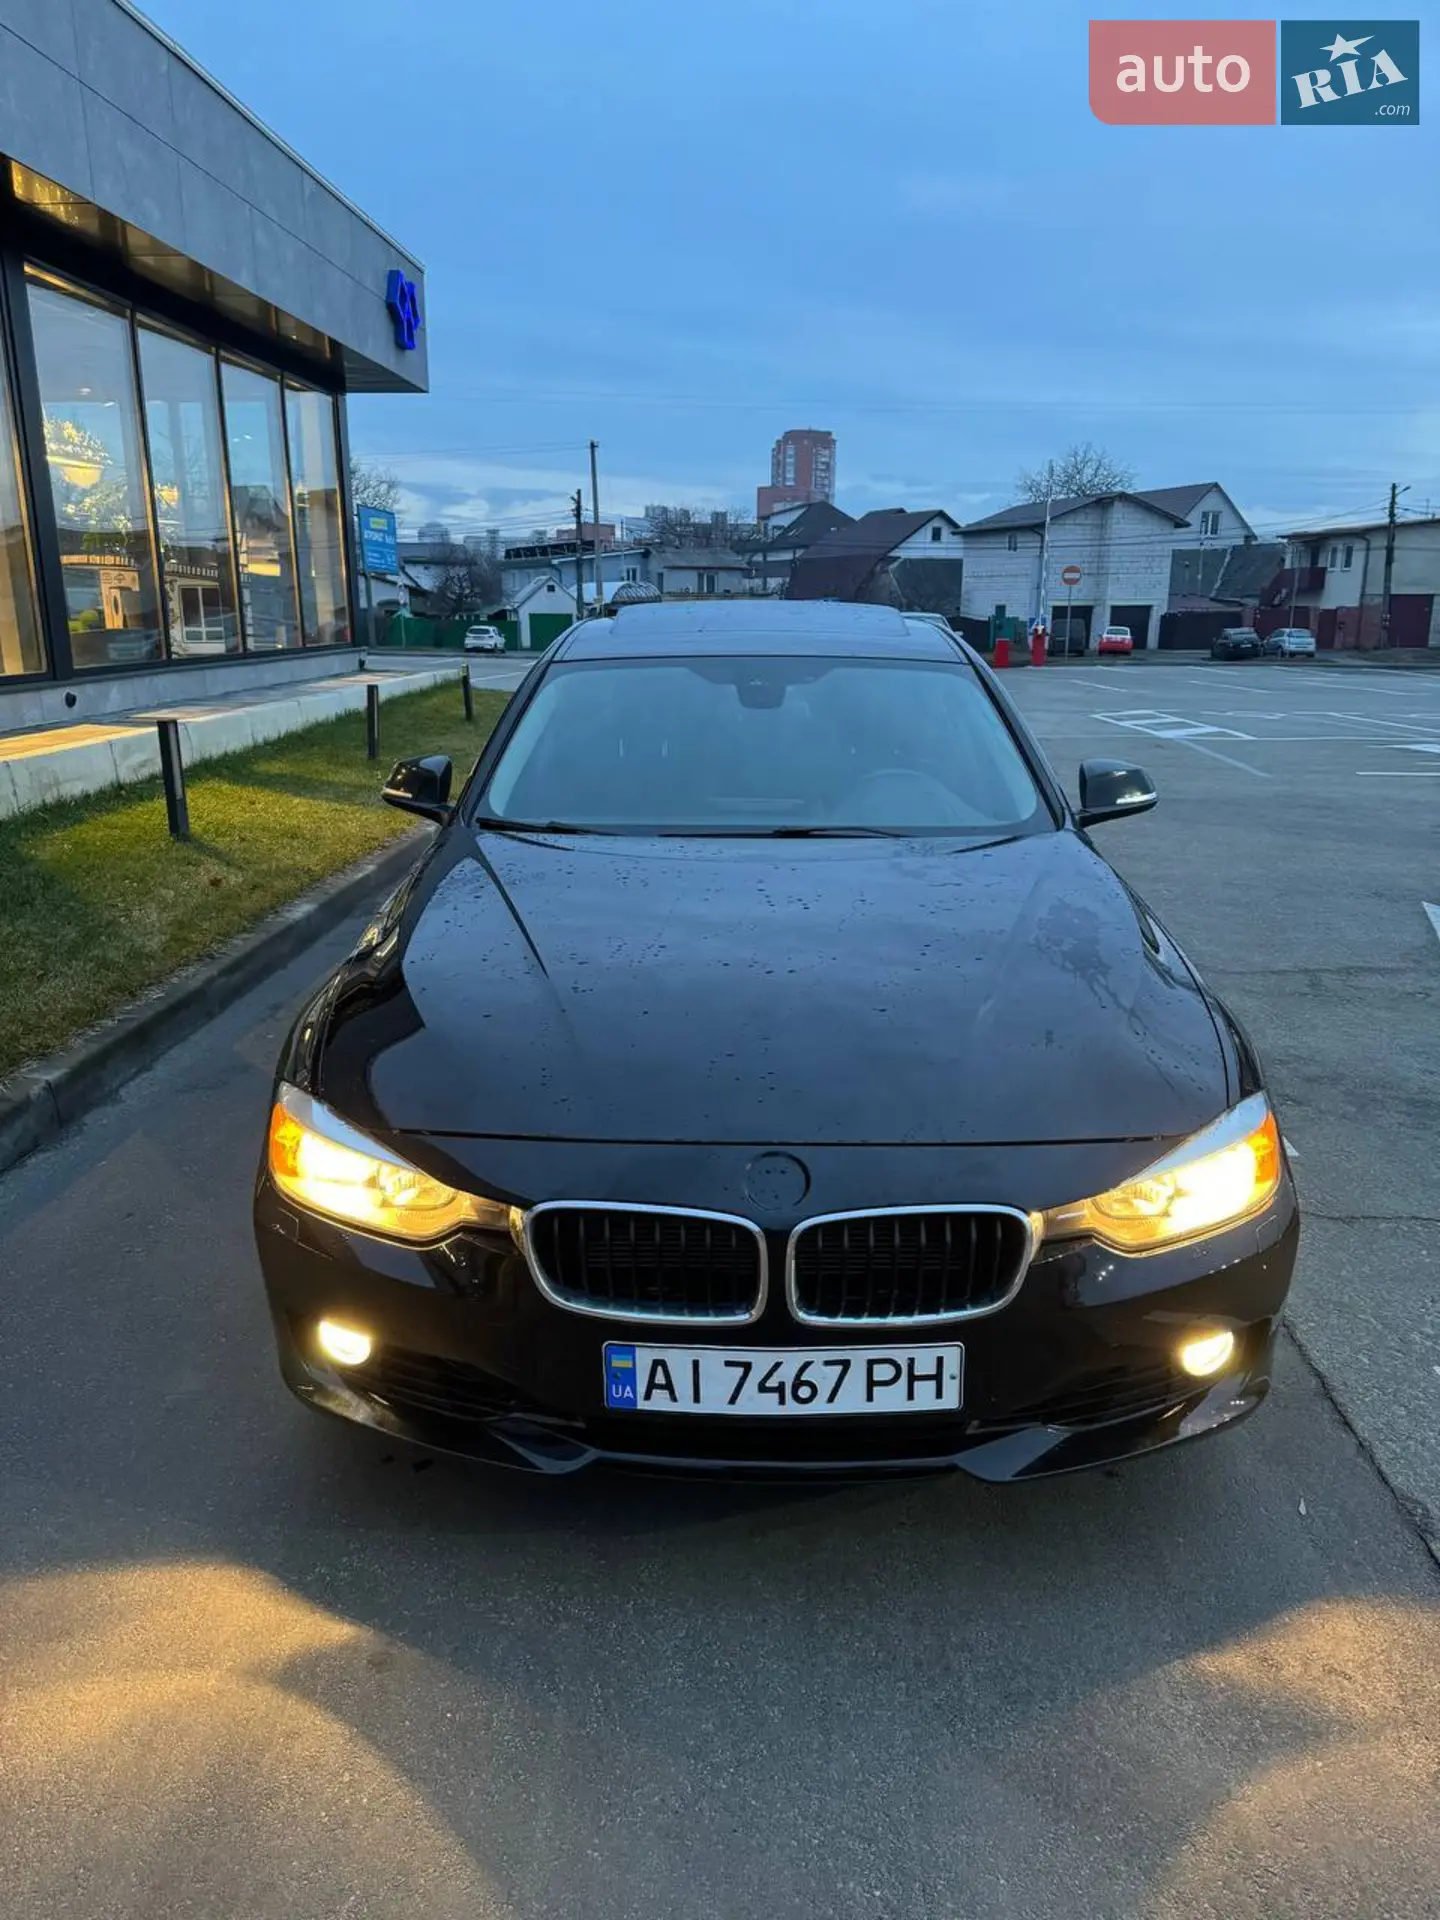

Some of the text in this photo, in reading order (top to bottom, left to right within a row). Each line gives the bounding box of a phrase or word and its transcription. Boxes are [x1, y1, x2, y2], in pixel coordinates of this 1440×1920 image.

[611, 1384, 635, 1399] UA
[643, 1356, 944, 1405] AI 7467 PH
